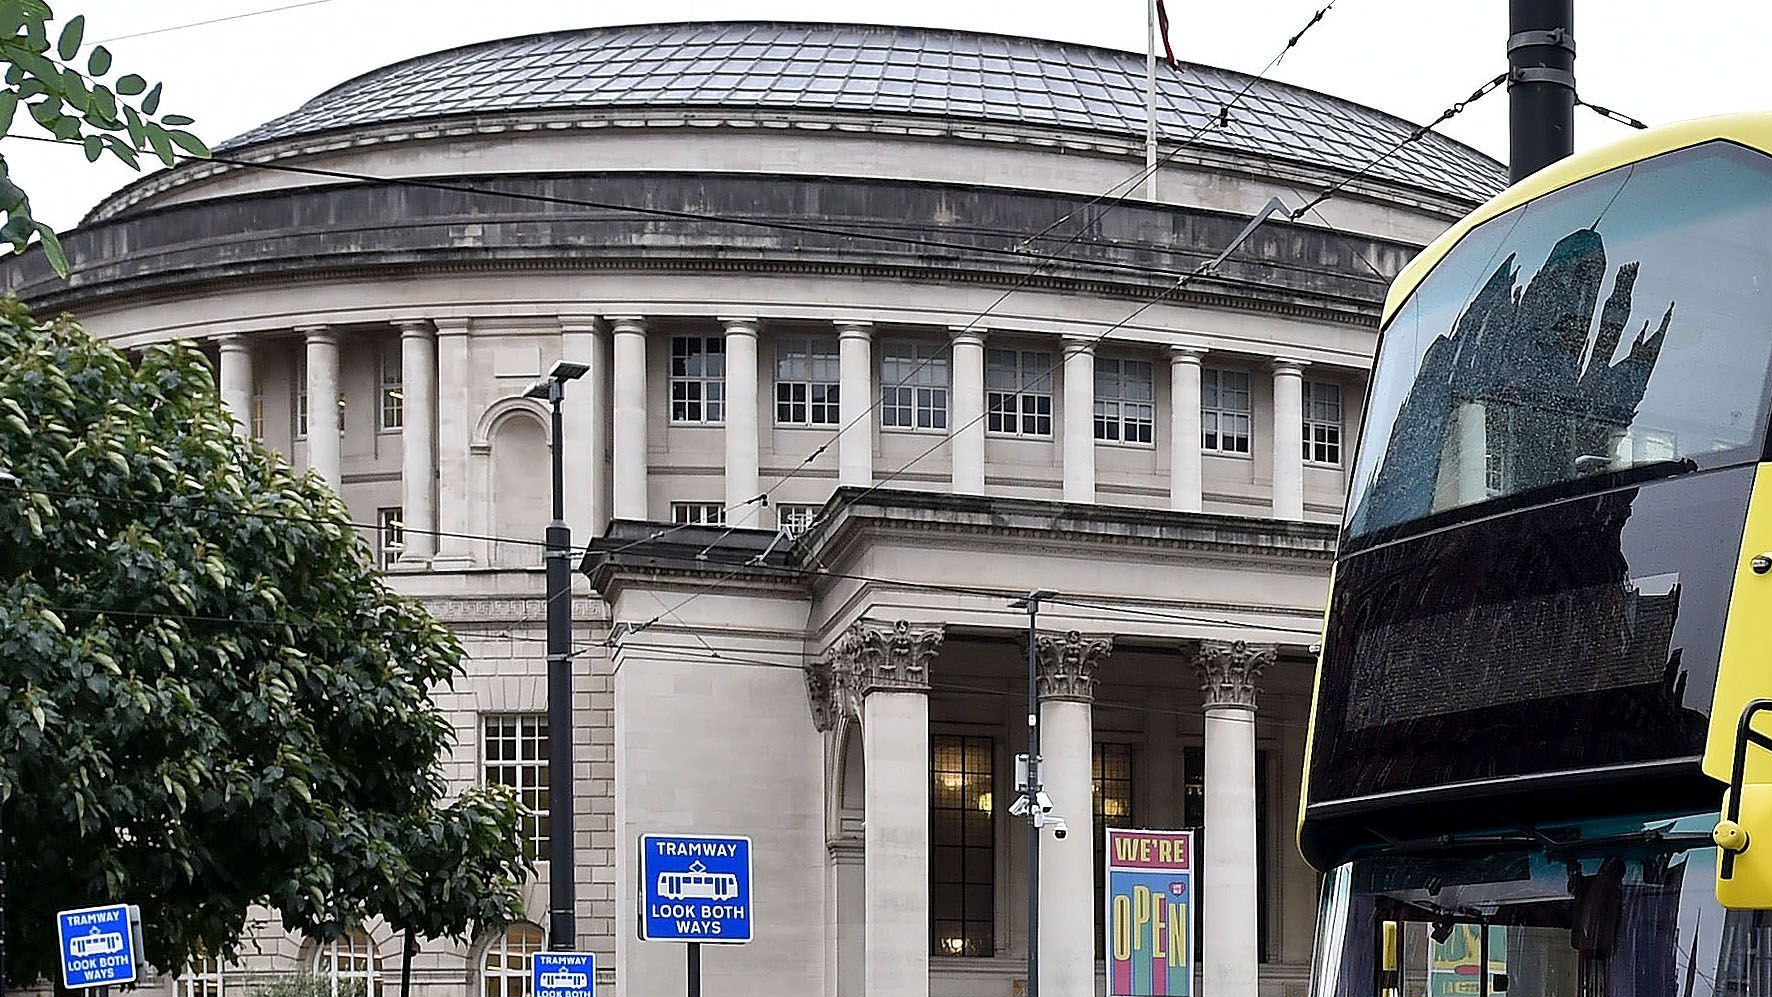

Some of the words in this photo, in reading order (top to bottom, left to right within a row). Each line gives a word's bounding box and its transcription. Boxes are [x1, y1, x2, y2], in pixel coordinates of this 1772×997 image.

[656, 842, 737, 857] TRAMWAY
[1115, 837, 1185, 863] WE'RE
[67, 911, 120, 927] TRAMWAY
[652, 904, 696, 918] LOOK
[701, 905, 744, 919] BOTH
[676, 920, 721, 934] WAYS
[1113, 885, 1187, 967] OPEN
[67, 958, 97, 972] LOOK
[99, 954, 129, 968] BOTH
[540, 956, 587, 965] TRAMWAY
[84, 967, 115, 981] WAYS
